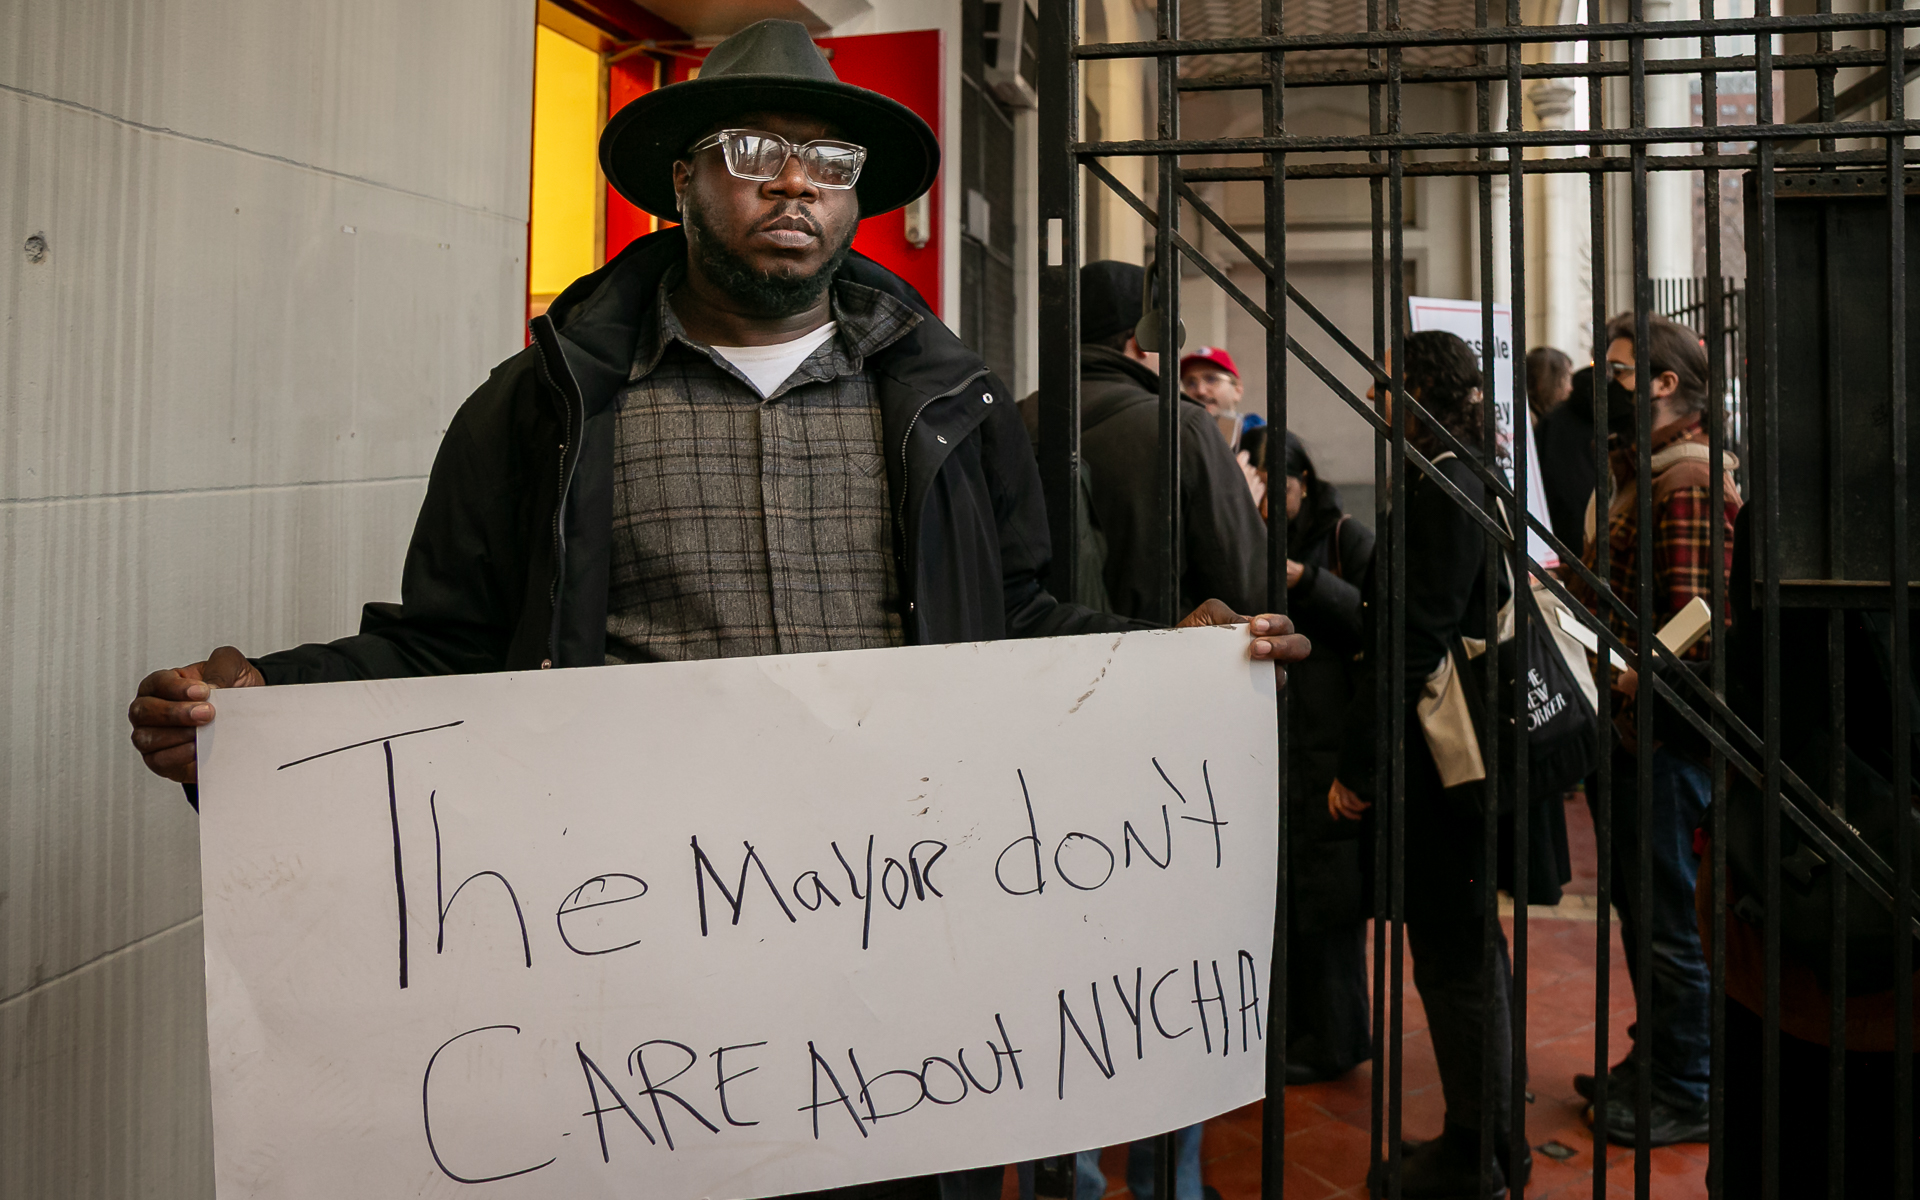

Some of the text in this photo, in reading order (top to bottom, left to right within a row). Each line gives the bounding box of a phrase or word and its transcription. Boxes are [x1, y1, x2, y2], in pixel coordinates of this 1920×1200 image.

[1527, 682, 1549, 710] EW
[1527, 692, 1568, 732] ORKER
[277, 720, 649, 989] The
[422, 1024, 768, 1184] CARE
[1057, 949, 1262, 1100] NYCHA
